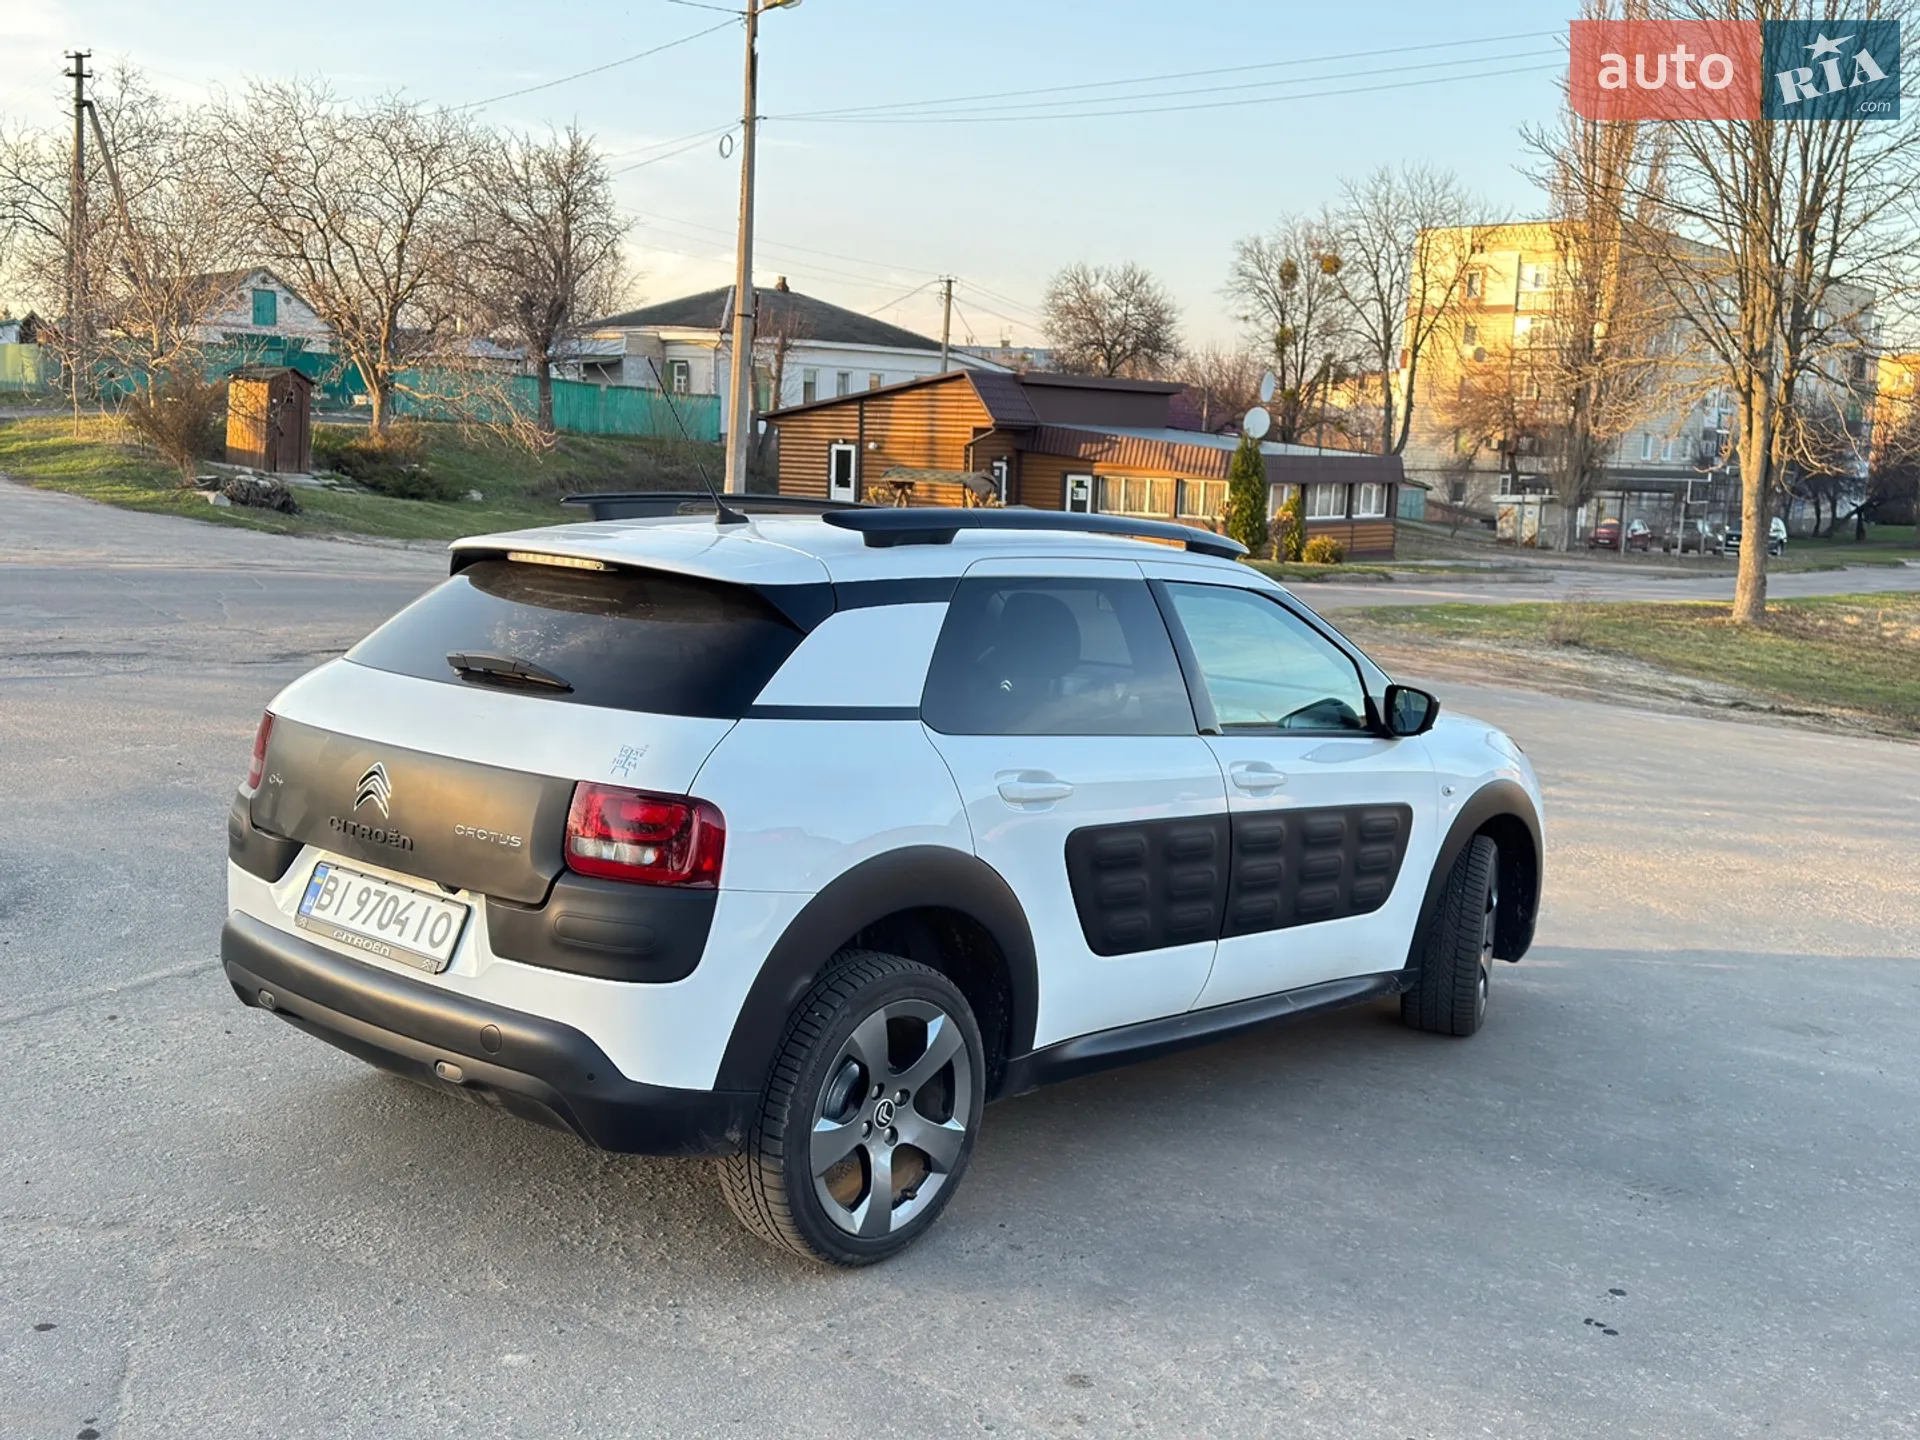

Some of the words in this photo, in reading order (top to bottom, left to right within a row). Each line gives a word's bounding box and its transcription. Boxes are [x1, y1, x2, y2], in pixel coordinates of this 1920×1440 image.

[328, 816, 414, 851] CITROËN
[454, 824, 522, 848] CACTUS
[315, 875, 352, 916] BI
[349, 886, 415, 938] 9704
[412, 906, 453, 949] IO
